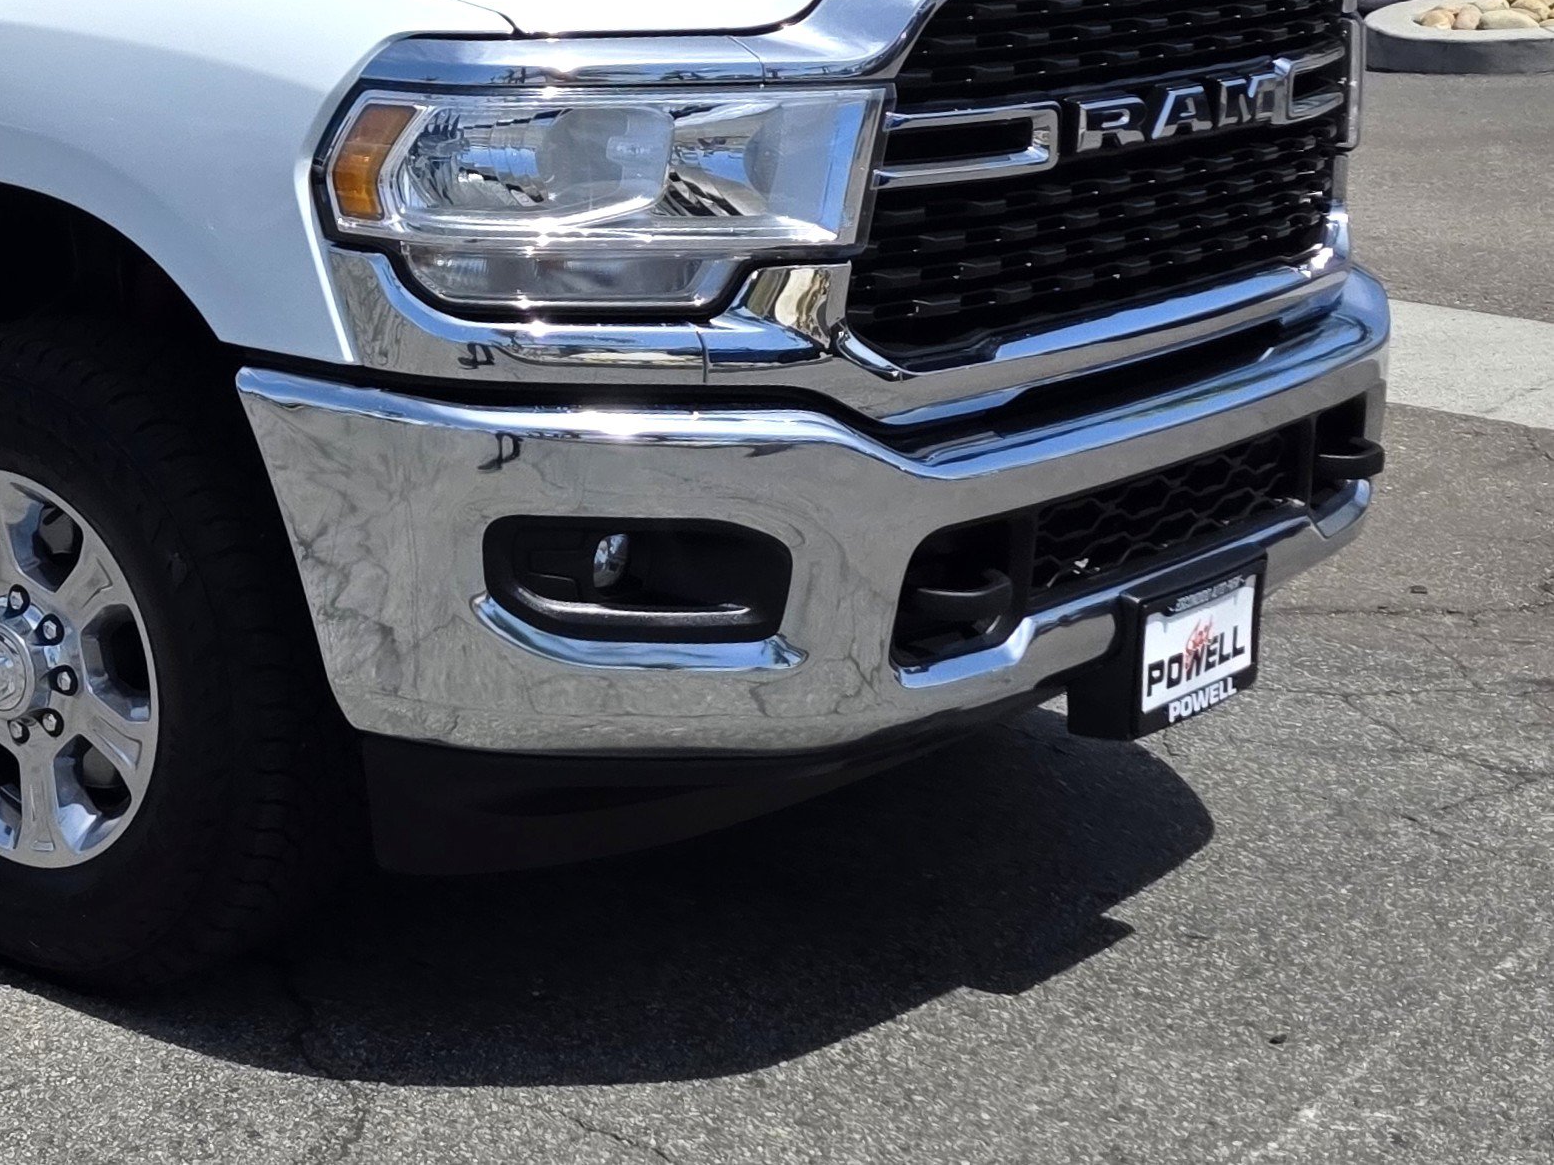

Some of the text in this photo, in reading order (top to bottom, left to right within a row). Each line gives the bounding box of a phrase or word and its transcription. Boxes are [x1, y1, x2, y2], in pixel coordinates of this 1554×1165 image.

[1072, 72, 1286, 153] RAM
[1147, 625, 1246, 698] POWELL
[1168, 677, 1237, 723] POWELL
